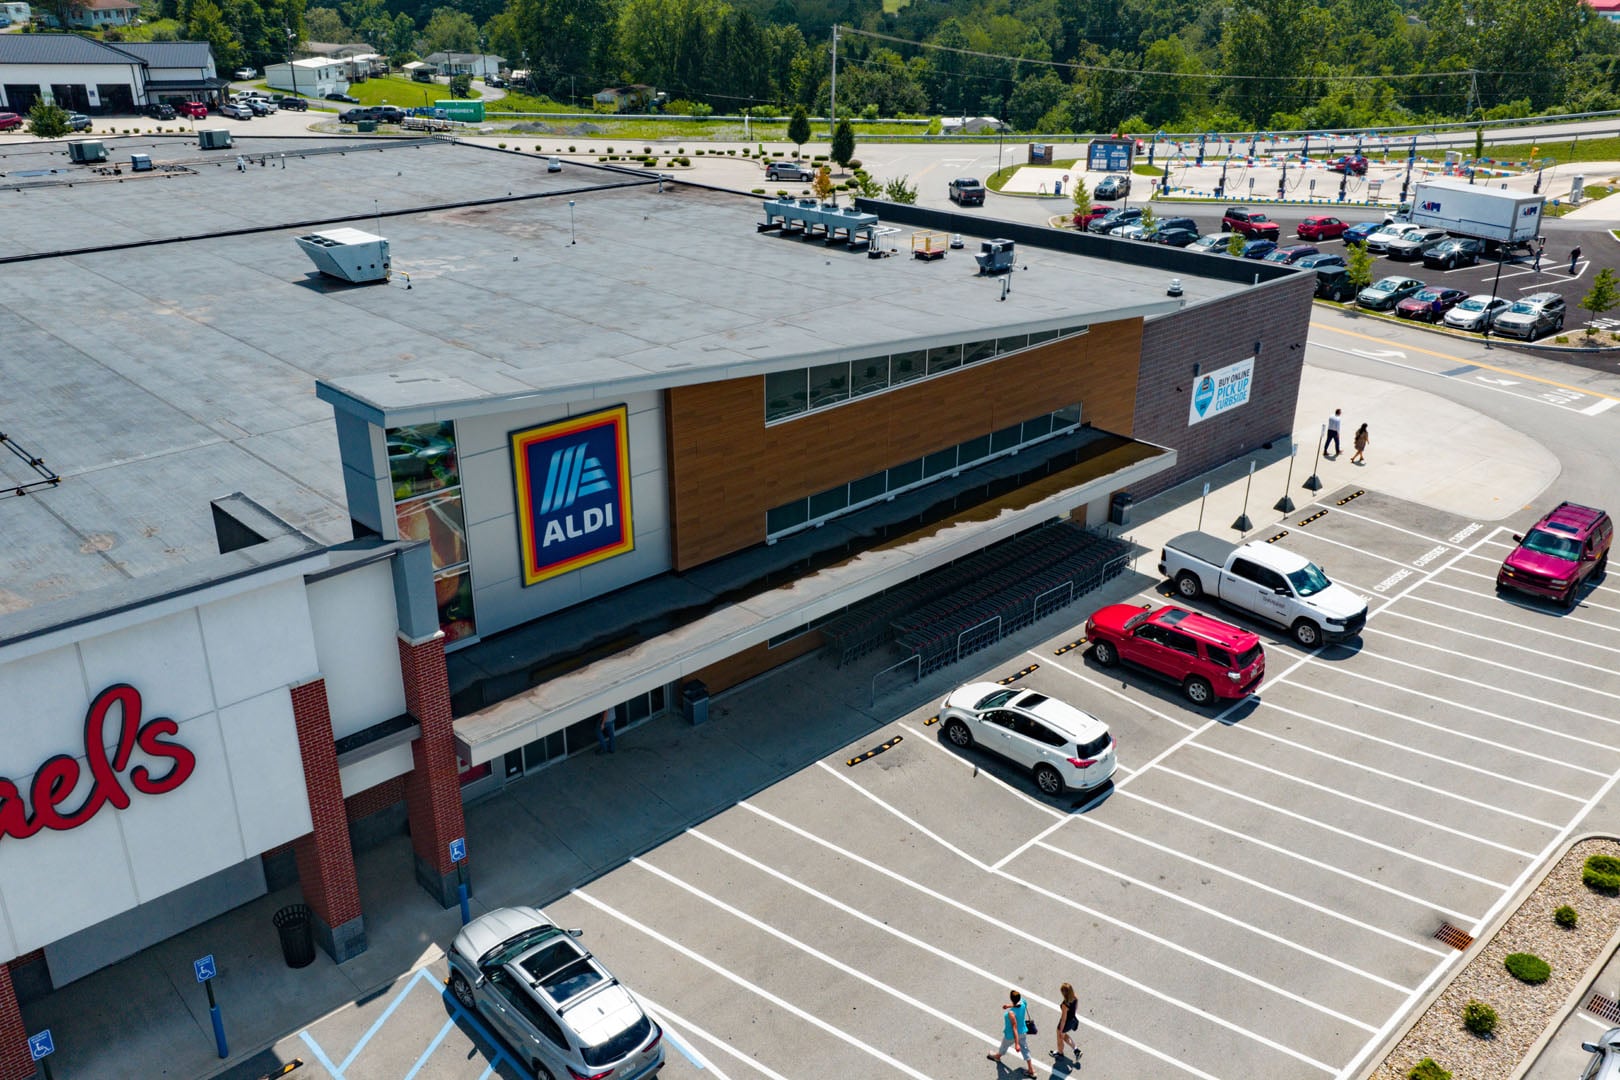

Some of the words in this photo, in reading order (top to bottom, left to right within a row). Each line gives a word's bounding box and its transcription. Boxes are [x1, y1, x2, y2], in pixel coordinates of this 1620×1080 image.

[1218, 375, 1231, 387] BUY
[1231, 368, 1250, 383] ONLINE
[1217, 382, 1236, 401] PICK
[1237, 377, 1249, 393] UP
[1215, 390, 1248, 411] CURBSIDE
[542, 502, 614, 548] ALDI
